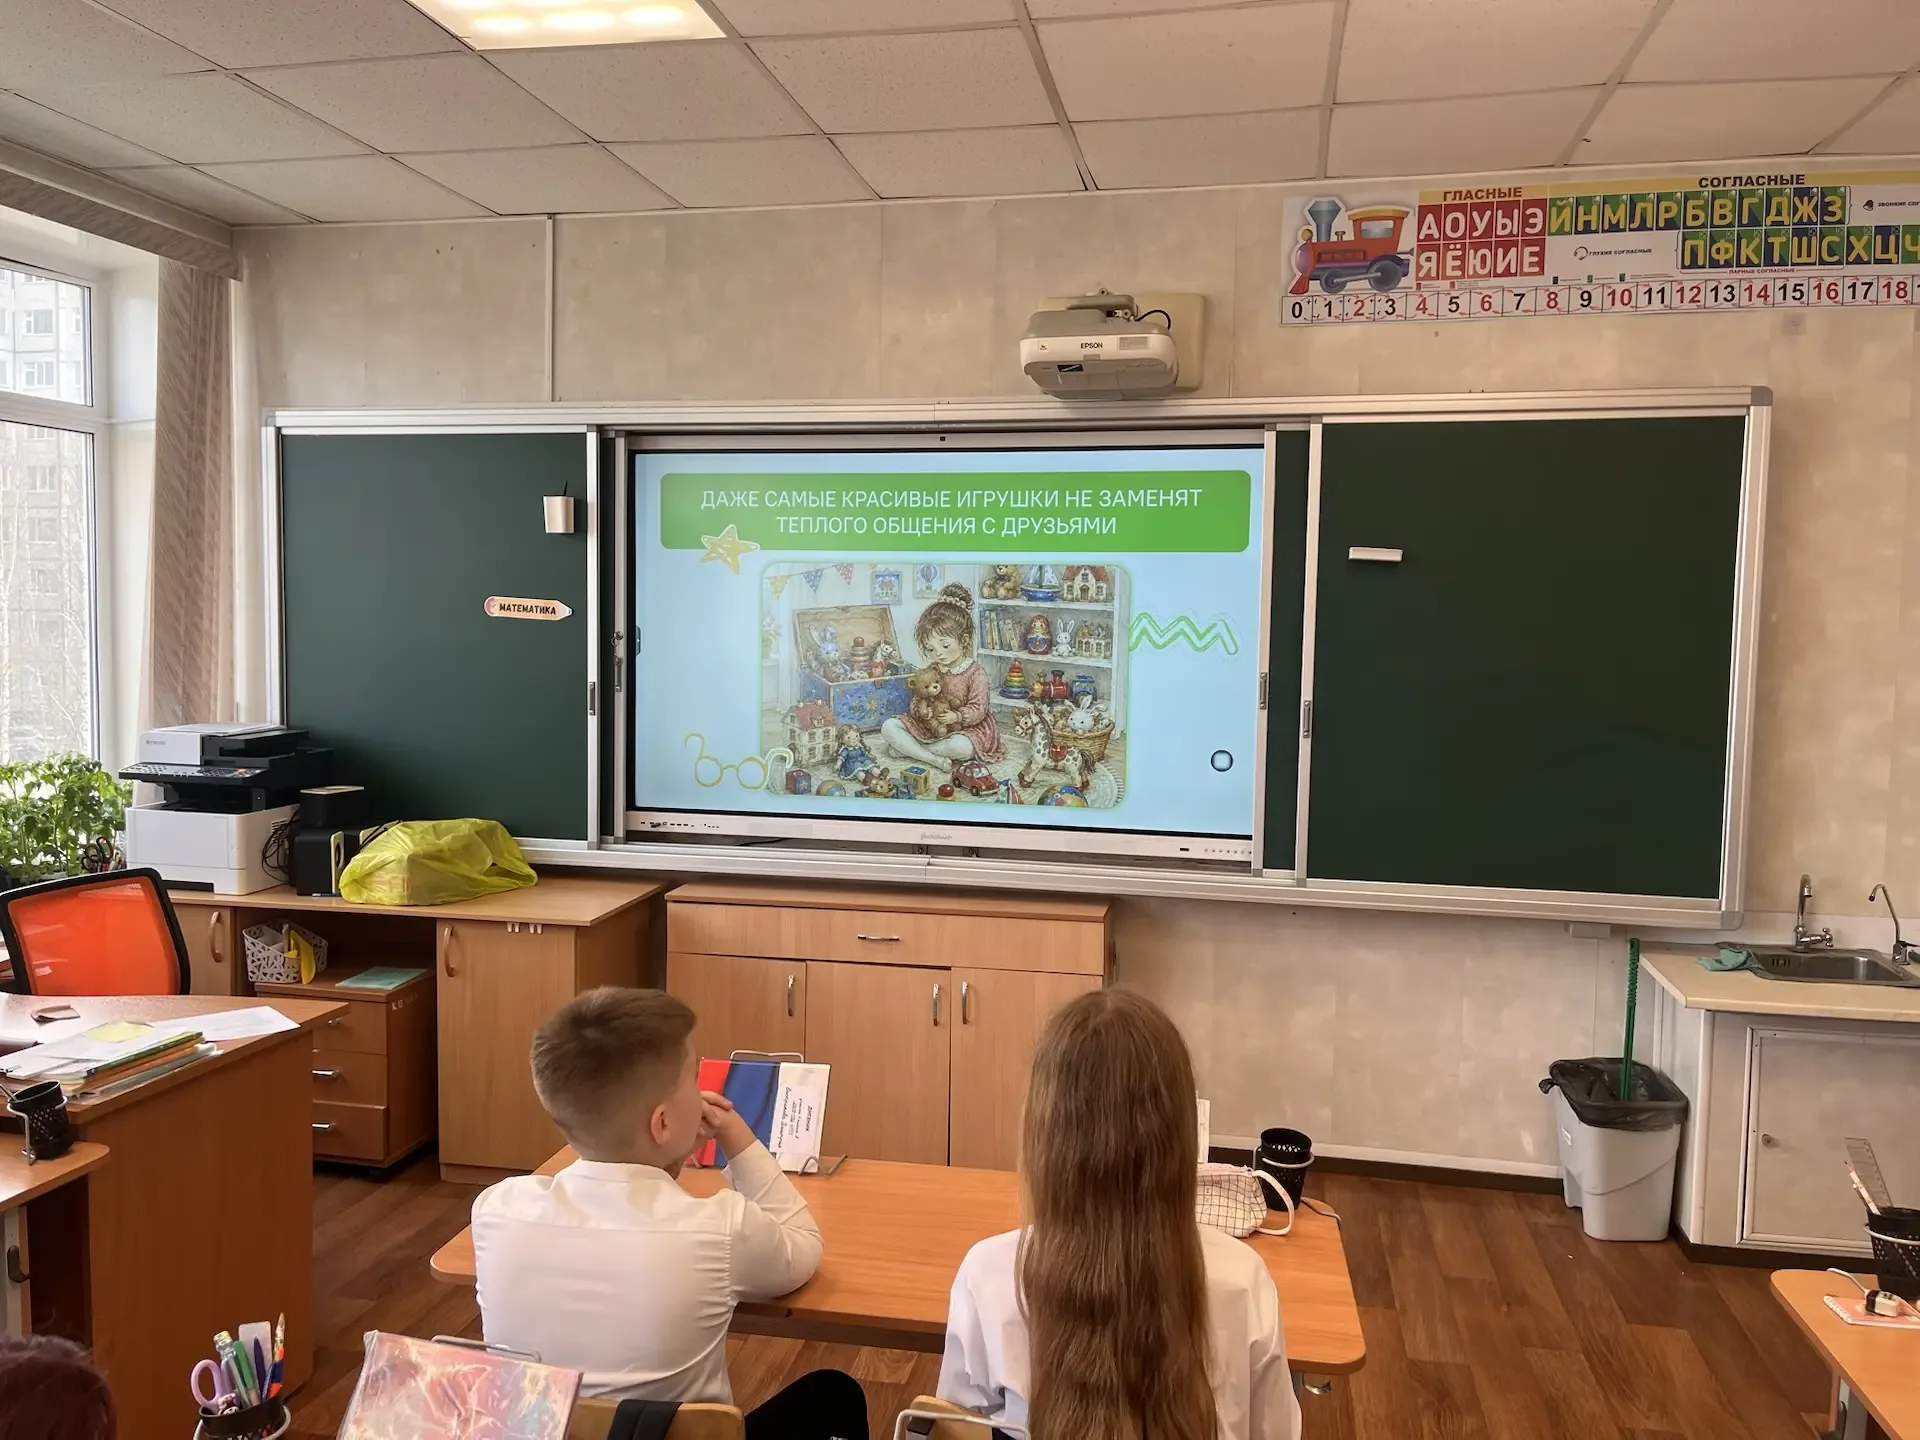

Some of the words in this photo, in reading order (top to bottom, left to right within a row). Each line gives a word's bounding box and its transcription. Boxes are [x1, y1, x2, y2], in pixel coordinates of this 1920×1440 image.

[1443, 187, 1522, 201] ГЛАСНЫЕ
[1698, 174, 1805, 188] СОГЛАСНЫЕ
[1419, 213, 1440, 240] А
[1472, 210, 1492, 237] У
[1496, 208, 1519, 235] Ы
[1524, 207, 1544, 234] Э
[1603, 203, 1627, 230] М
[1686, 199, 1706, 226] Б
[1741, 197, 1759, 225] Г
[1766, 196, 1790, 226] Д
[1793, 196, 1818, 223] Ж
[1418, 251, 1438, 278] Я
[1446, 243, 1463, 276] Ё
[1469, 248, 1492, 275] Ю
[1684, 239, 1705, 267] П
[1711, 238, 1734, 265] Ф
[1740, 237, 1760, 265] К
[1791, 236, 1817, 264] Ш
[1821, 235, 1841, 262] С
[1875, 234, 1898, 264] Ц
[1291, 301, 1303, 318] 0
[1324, 300, 1332, 317] 1
[1353, 299, 1365, 317] 2
[1384, 298, 1396, 316] 3
[1415, 297, 1428, 315] 4
[1448, 295, 1460, 313] 5
[1480, 294, 1493, 312] 6
[1513, 293, 1526, 310] 7
[1546, 291, 1559, 309] 8
[1579, 290, 1592, 307] 9
[1607, 288, 1633, 307] 10
[1643, 286, 1666, 305] 11
[1676, 285, 1701, 304] 12
[1710, 284, 1736, 303] 13
[1743, 283, 1770, 302] 14
[1778, 283, 1804, 301] 15
[1812, 282, 1839, 300] 16
[1847, 282, 1874, 300] 17
[1882, 281, 1908, 299] 18
[701, 491, 759, 510] ДАЖЕ
[764, 491, 837, 507] САМЫЕ
[842, 490, 951, 507] КРАСИВЫЕ
[957, 491, 1059, 507] ИГРУШКИ
[1065, 490, 1093, 506] НЕ
[1099, 489, 1203, 507] ЗАМЕНЯТ
[776, 517, 867, 533] ТЕПЛОГО
[873, 517, 976, 537] ОБЩЕНИЯ
[1001, 517, 1117, 537] ДРУЗЬЯМИ
[499, 603, 556, 615] МАТЕМАТИКА
